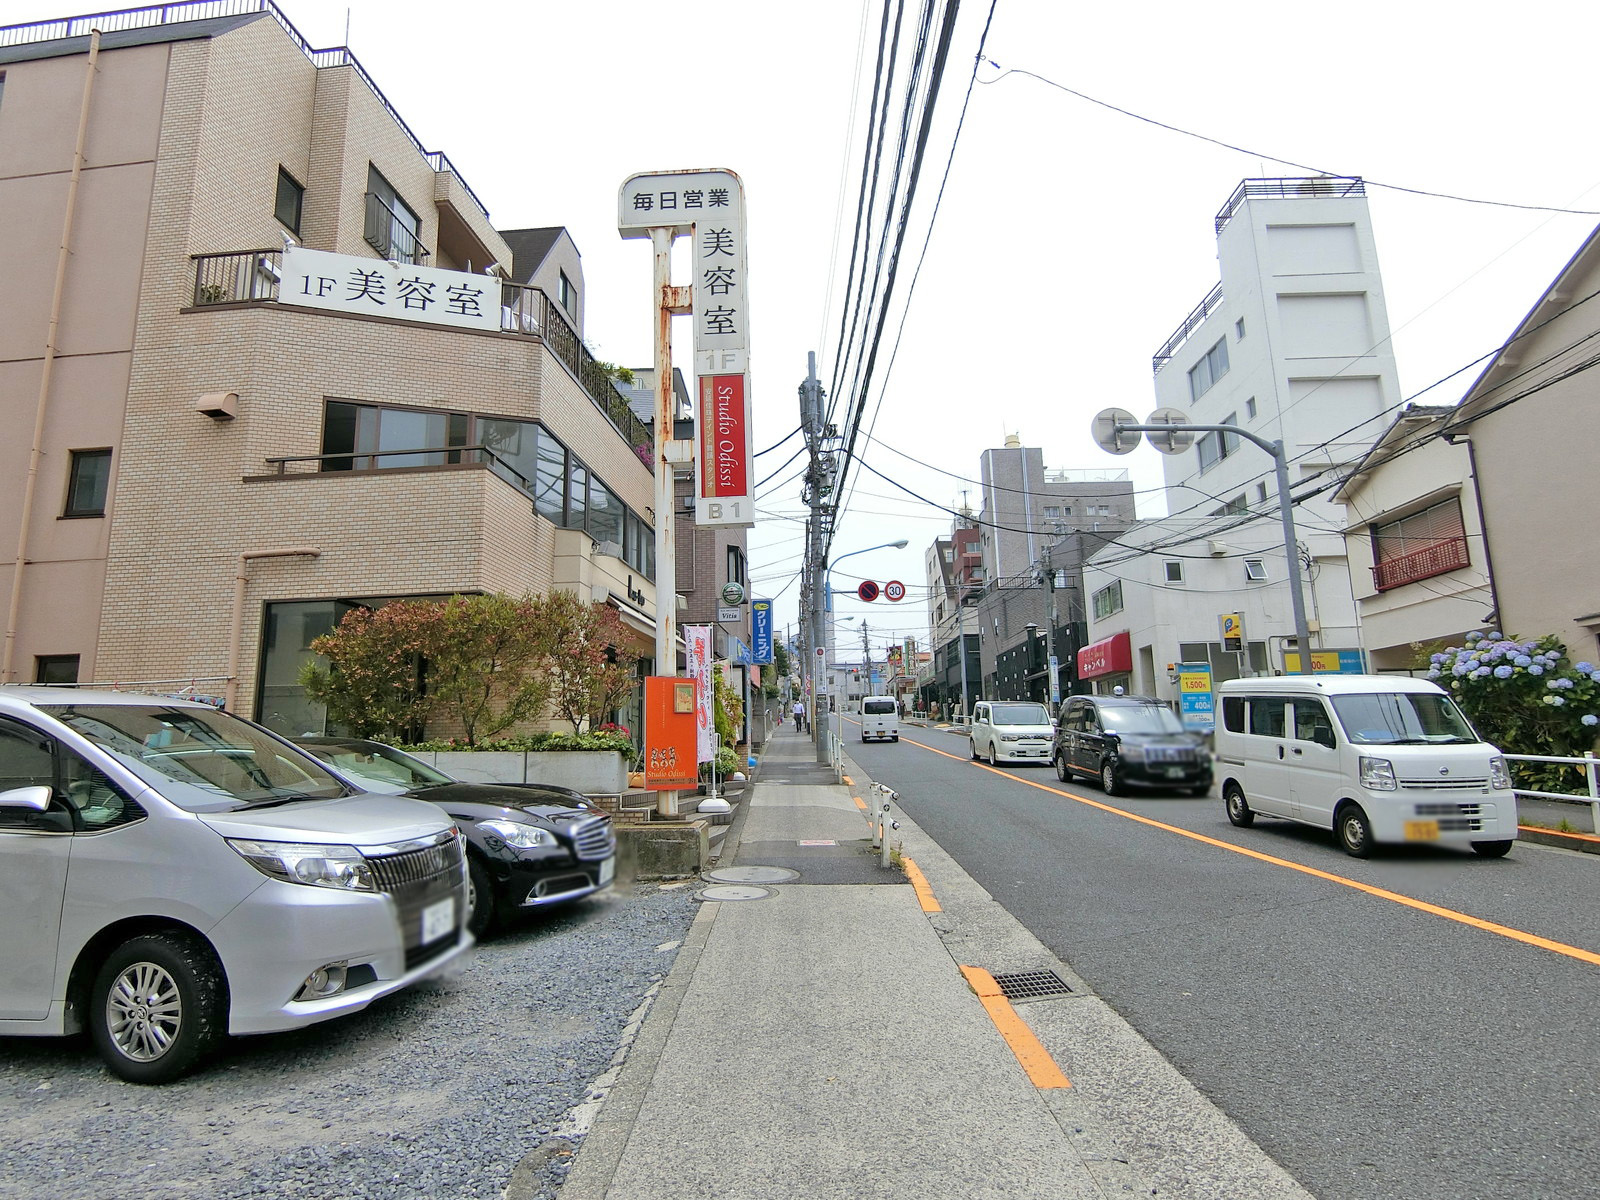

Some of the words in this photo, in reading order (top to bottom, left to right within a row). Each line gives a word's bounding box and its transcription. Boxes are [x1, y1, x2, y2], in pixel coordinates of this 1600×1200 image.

[633, 188, 729, 211] 毎日営業
[703, 227, 737, 335] 美容室
[705, 353, 736, 370] 1F
[718, 385, 738, 435] Studio
[718, 440, 739, 488] Odissi
[708, 502, 741, 520] B1
[889, 586, 901, 596] 30
[757, 610, 770, 659] クリーニング
